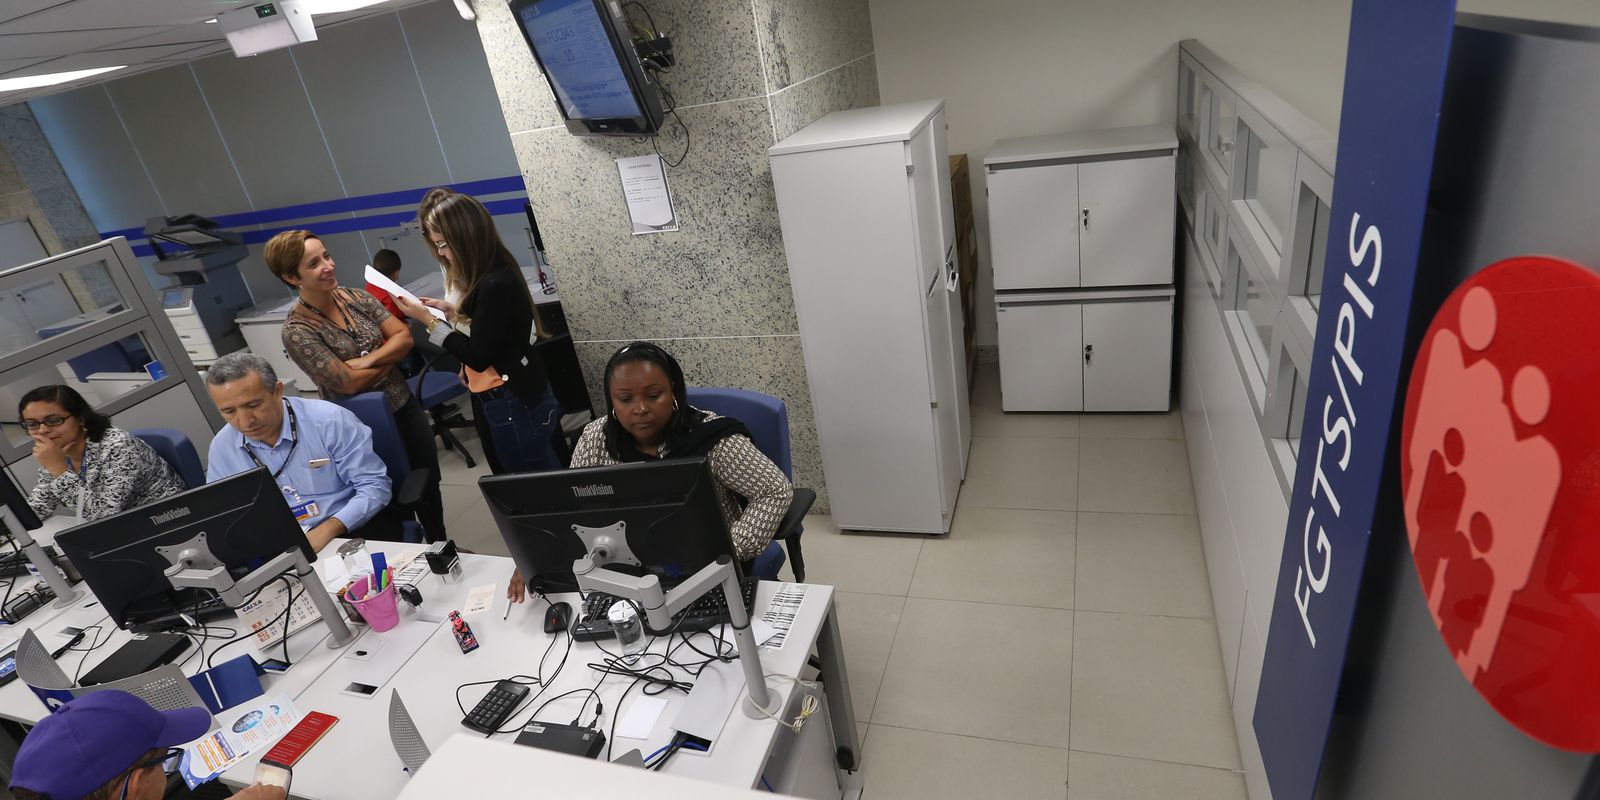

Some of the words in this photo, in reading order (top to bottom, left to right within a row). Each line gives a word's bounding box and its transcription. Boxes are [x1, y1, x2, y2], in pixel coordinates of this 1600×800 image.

[1294, 212, 1383, 648] FGTS/PIS
[571, 484, 615, 497] ThinkVision
[149, 507, 191, 525] ThinkVision
[242, 599, 263, 612] CAIXA
[277, 583, 296, 594] MARO
